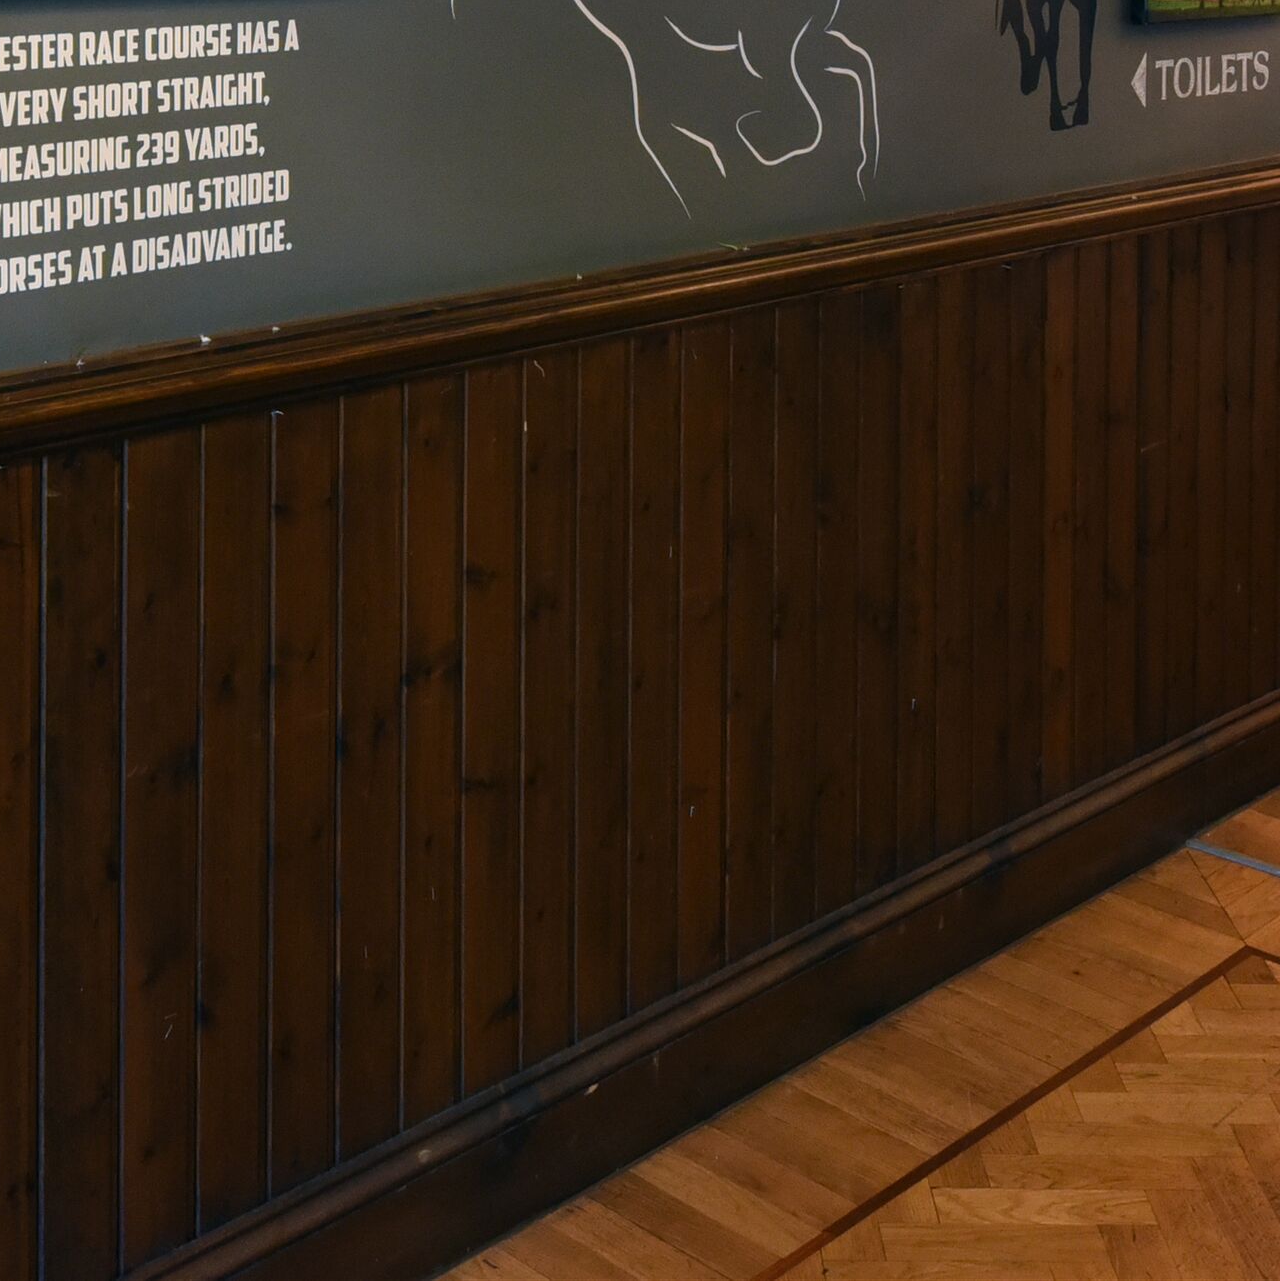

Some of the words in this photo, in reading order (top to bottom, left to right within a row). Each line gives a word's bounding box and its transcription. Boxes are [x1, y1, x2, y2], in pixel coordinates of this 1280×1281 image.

[79, 29, 139, 66] RACE
[145, 23, 232, 61] COURSE
[237, 21, 280, 54] HAS
[284, 19, 299, 51] A
[0, 88, 67, 127] VERY
[73, 80, 152, 120] SHORT
[157, 71, 270, 112] STRAIGHT,
[1155, 51, 1269, 100] TOILETS
[136, 131, 179, 167] 239
[184, 123, 265, 160] YARDS,
[66, 189, 128, 229] PUTS
[134, 181, 193, 219] LONG
[199, 169, 289, 211] STRIDED
[77, 245, 106, 282] AT
[111, 242, 127, 277] A
[132, 220, 292, 273] DISADVANTGE.
